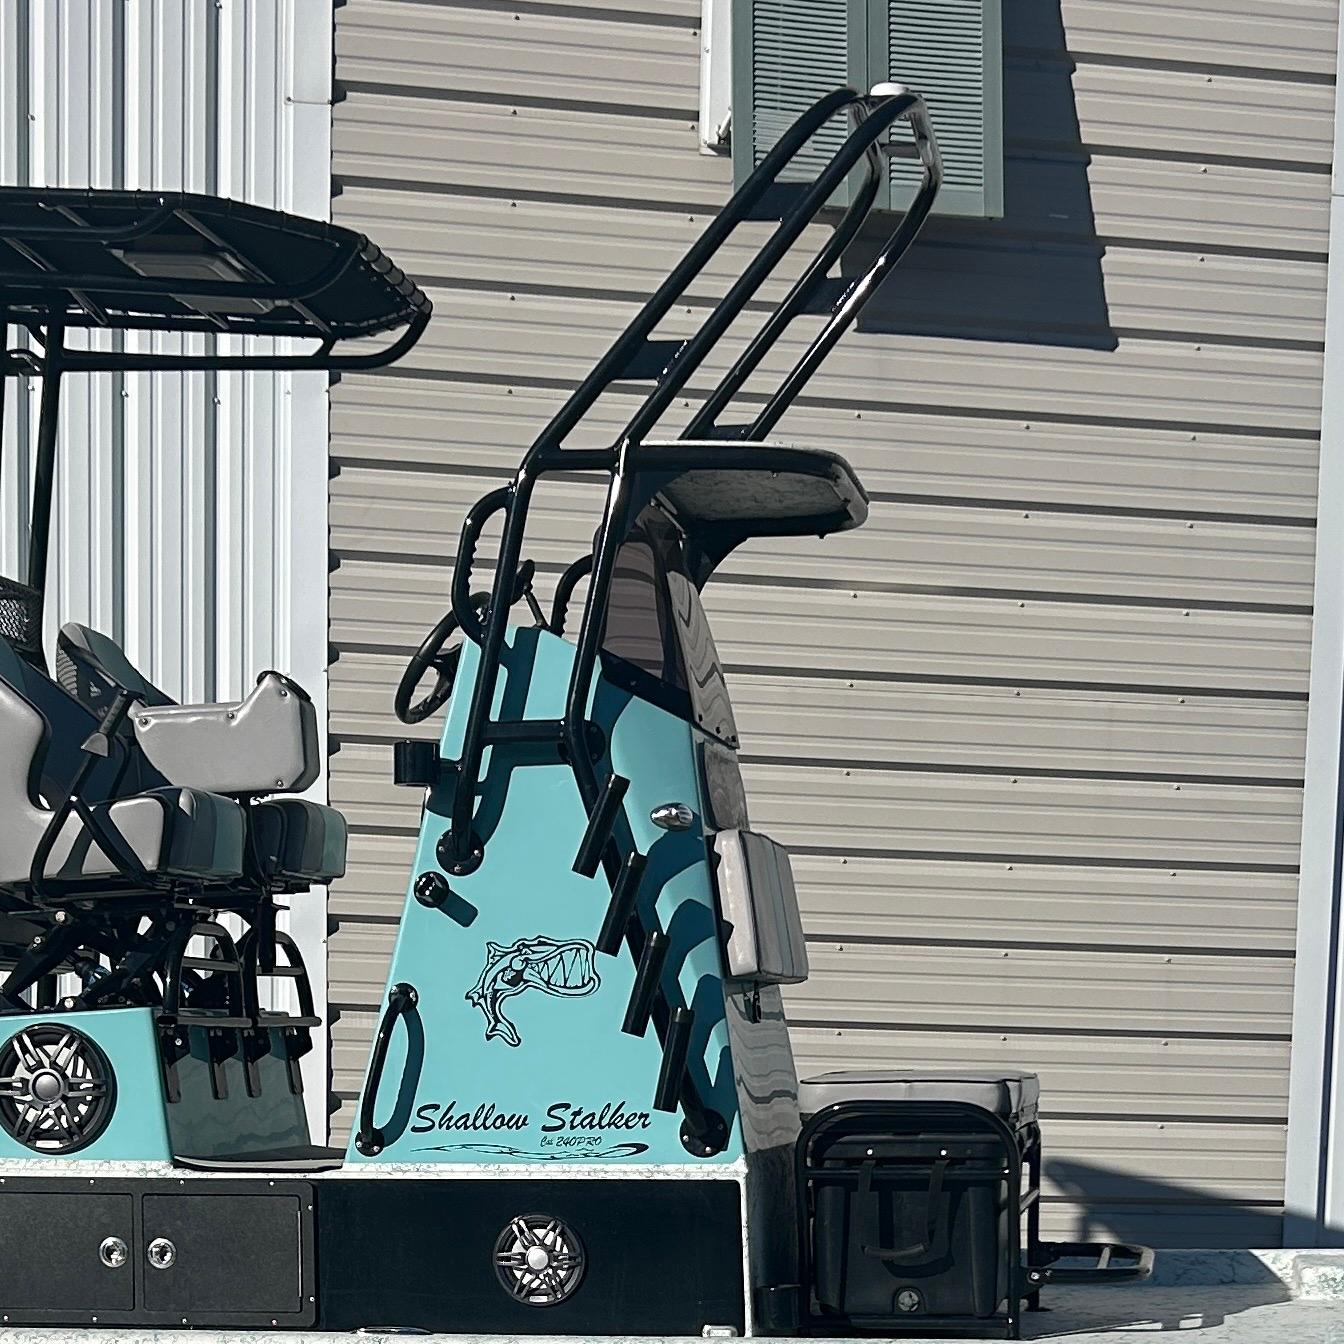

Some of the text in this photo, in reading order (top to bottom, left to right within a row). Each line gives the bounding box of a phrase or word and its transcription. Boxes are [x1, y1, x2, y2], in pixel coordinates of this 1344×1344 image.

[410, 1100, 652, 1133] Shallow Stalker
[555, 1135, 603, 1148] 240PRO
